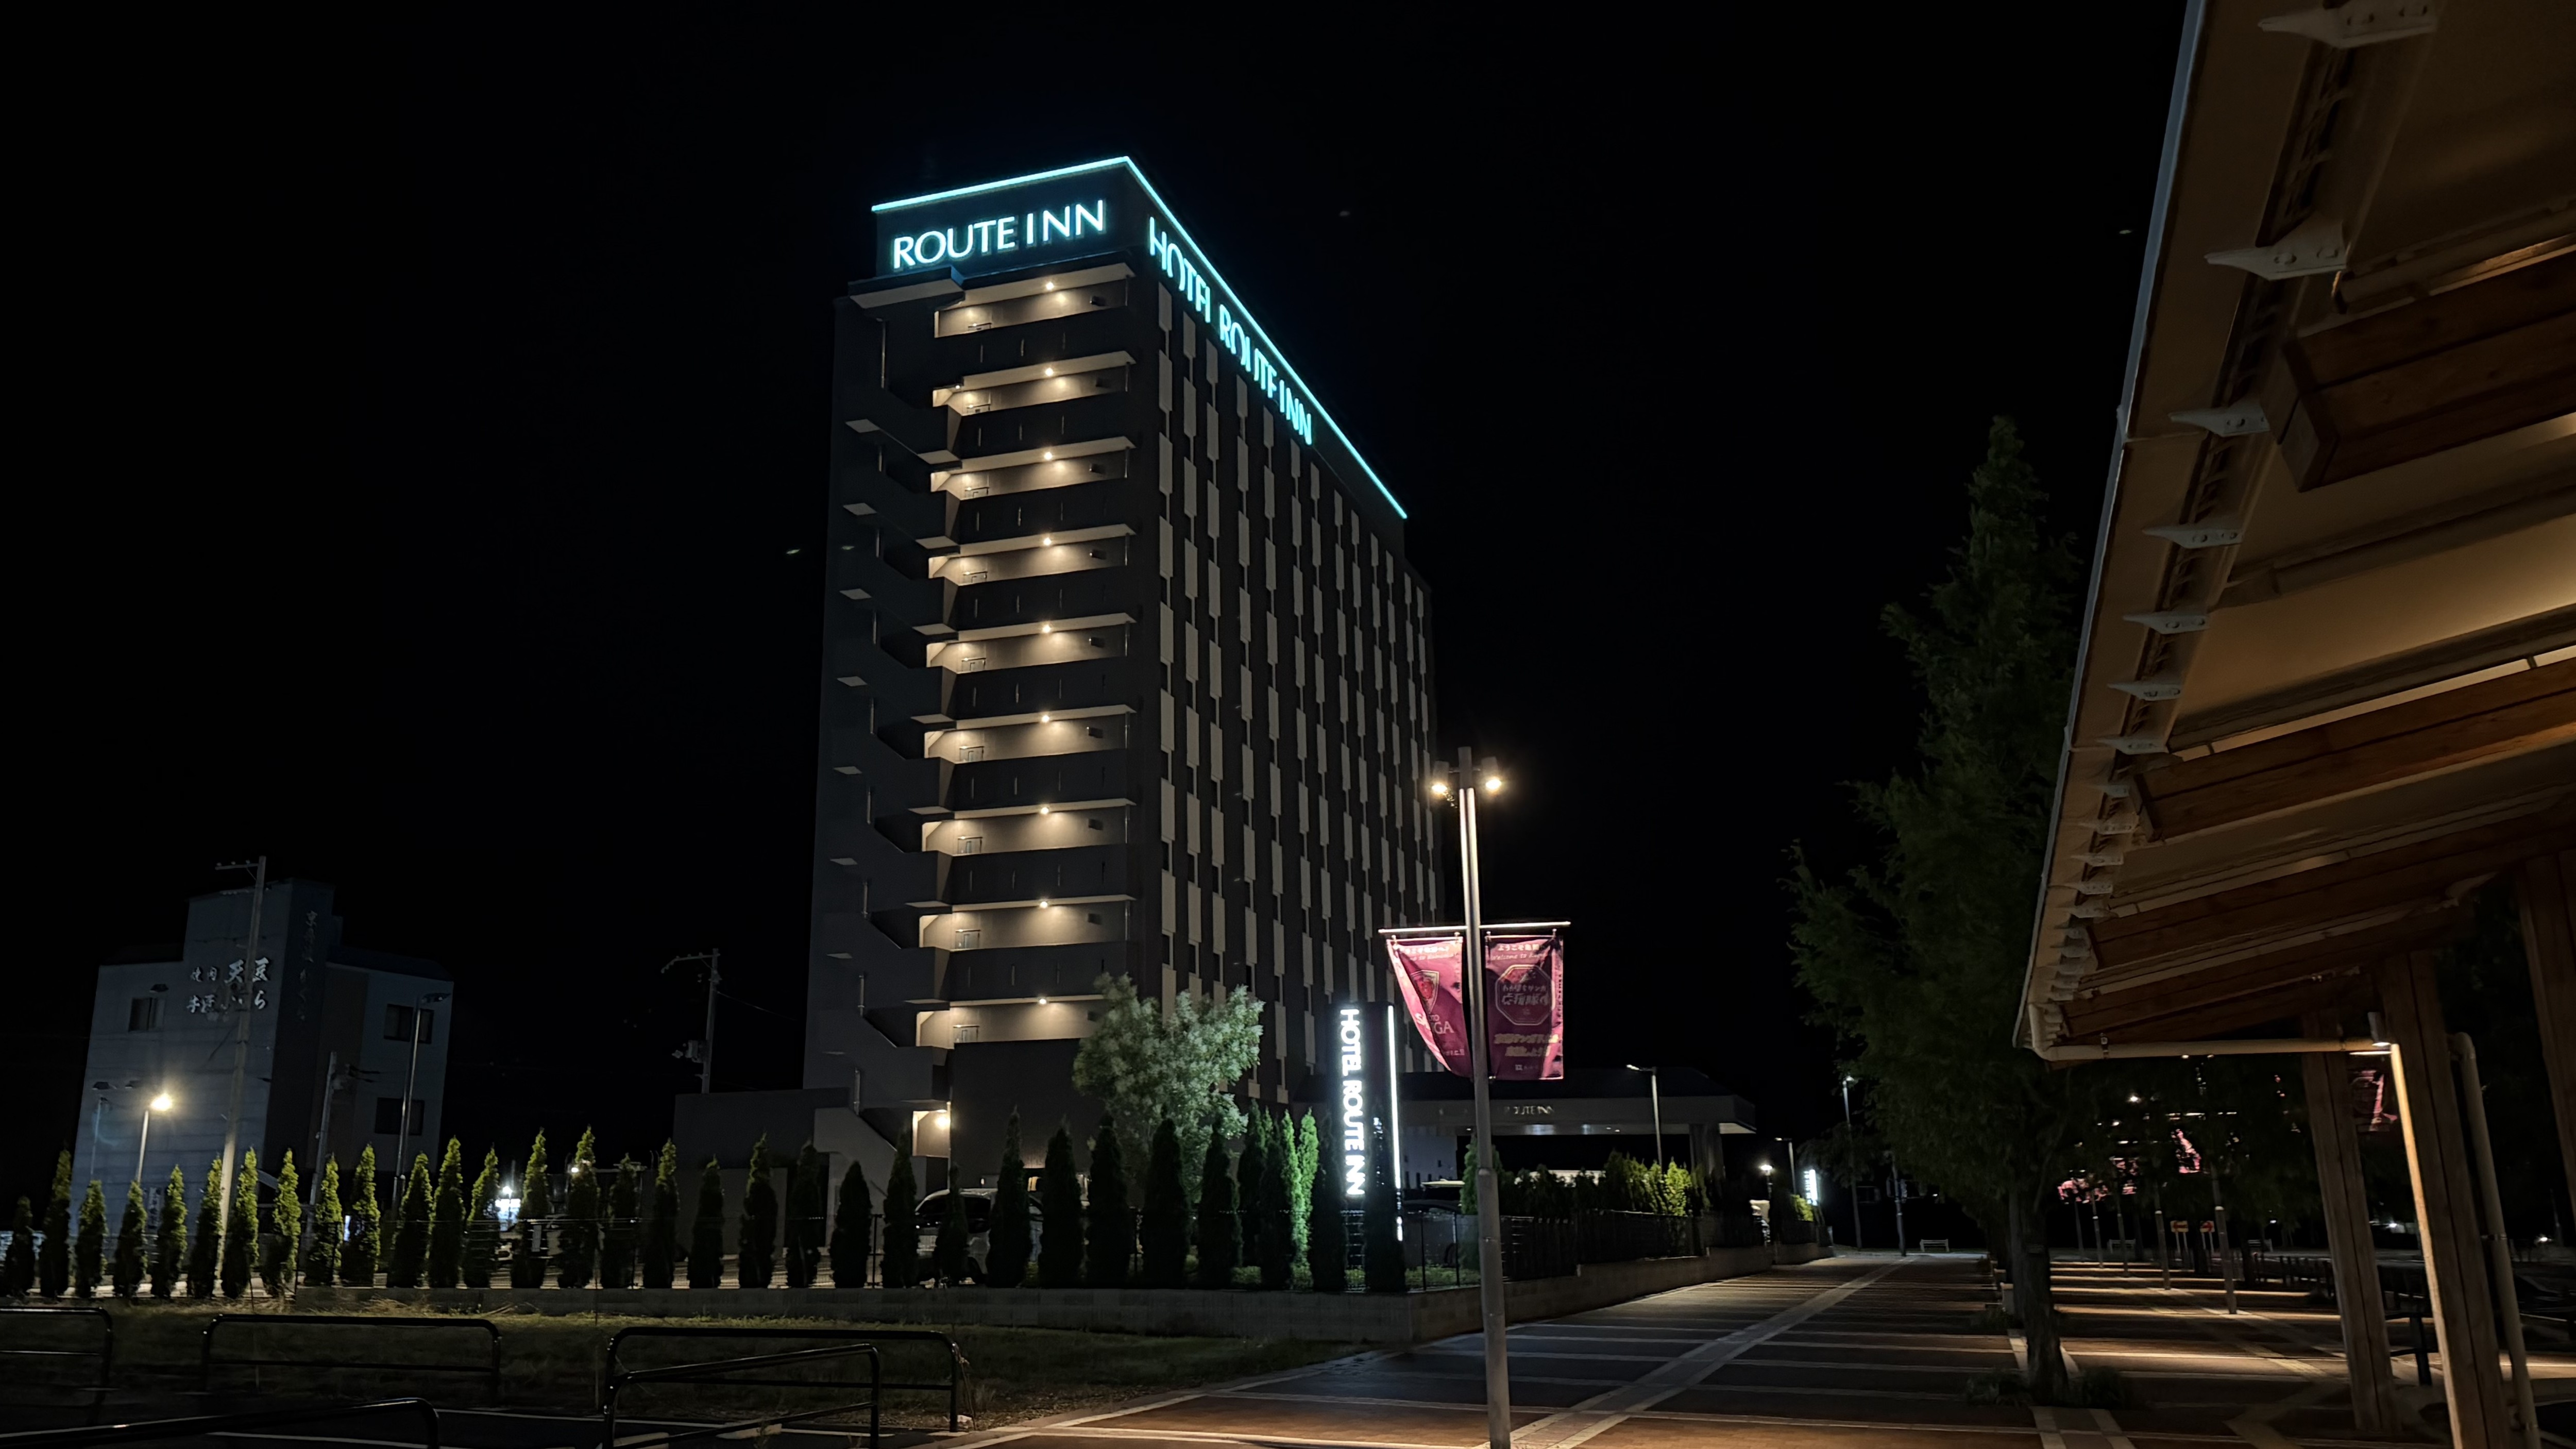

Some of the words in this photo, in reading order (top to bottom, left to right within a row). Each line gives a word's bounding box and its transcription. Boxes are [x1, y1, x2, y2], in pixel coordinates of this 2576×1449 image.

[893, 216, 1016, 268] ROUTE
[1026, 199, 1105, 245] INN
[1149, 216, 1211, 323] HOTEL
[1219, 303, 1278, 399] ROUTE
[1279, 379, 1313, 446] INN
[1341, 1008, 1361, 1077] HOTEL
[1343, 1080, 1365, 1151] ROUTE
[1346, 1154, 1366, 1196] INN
